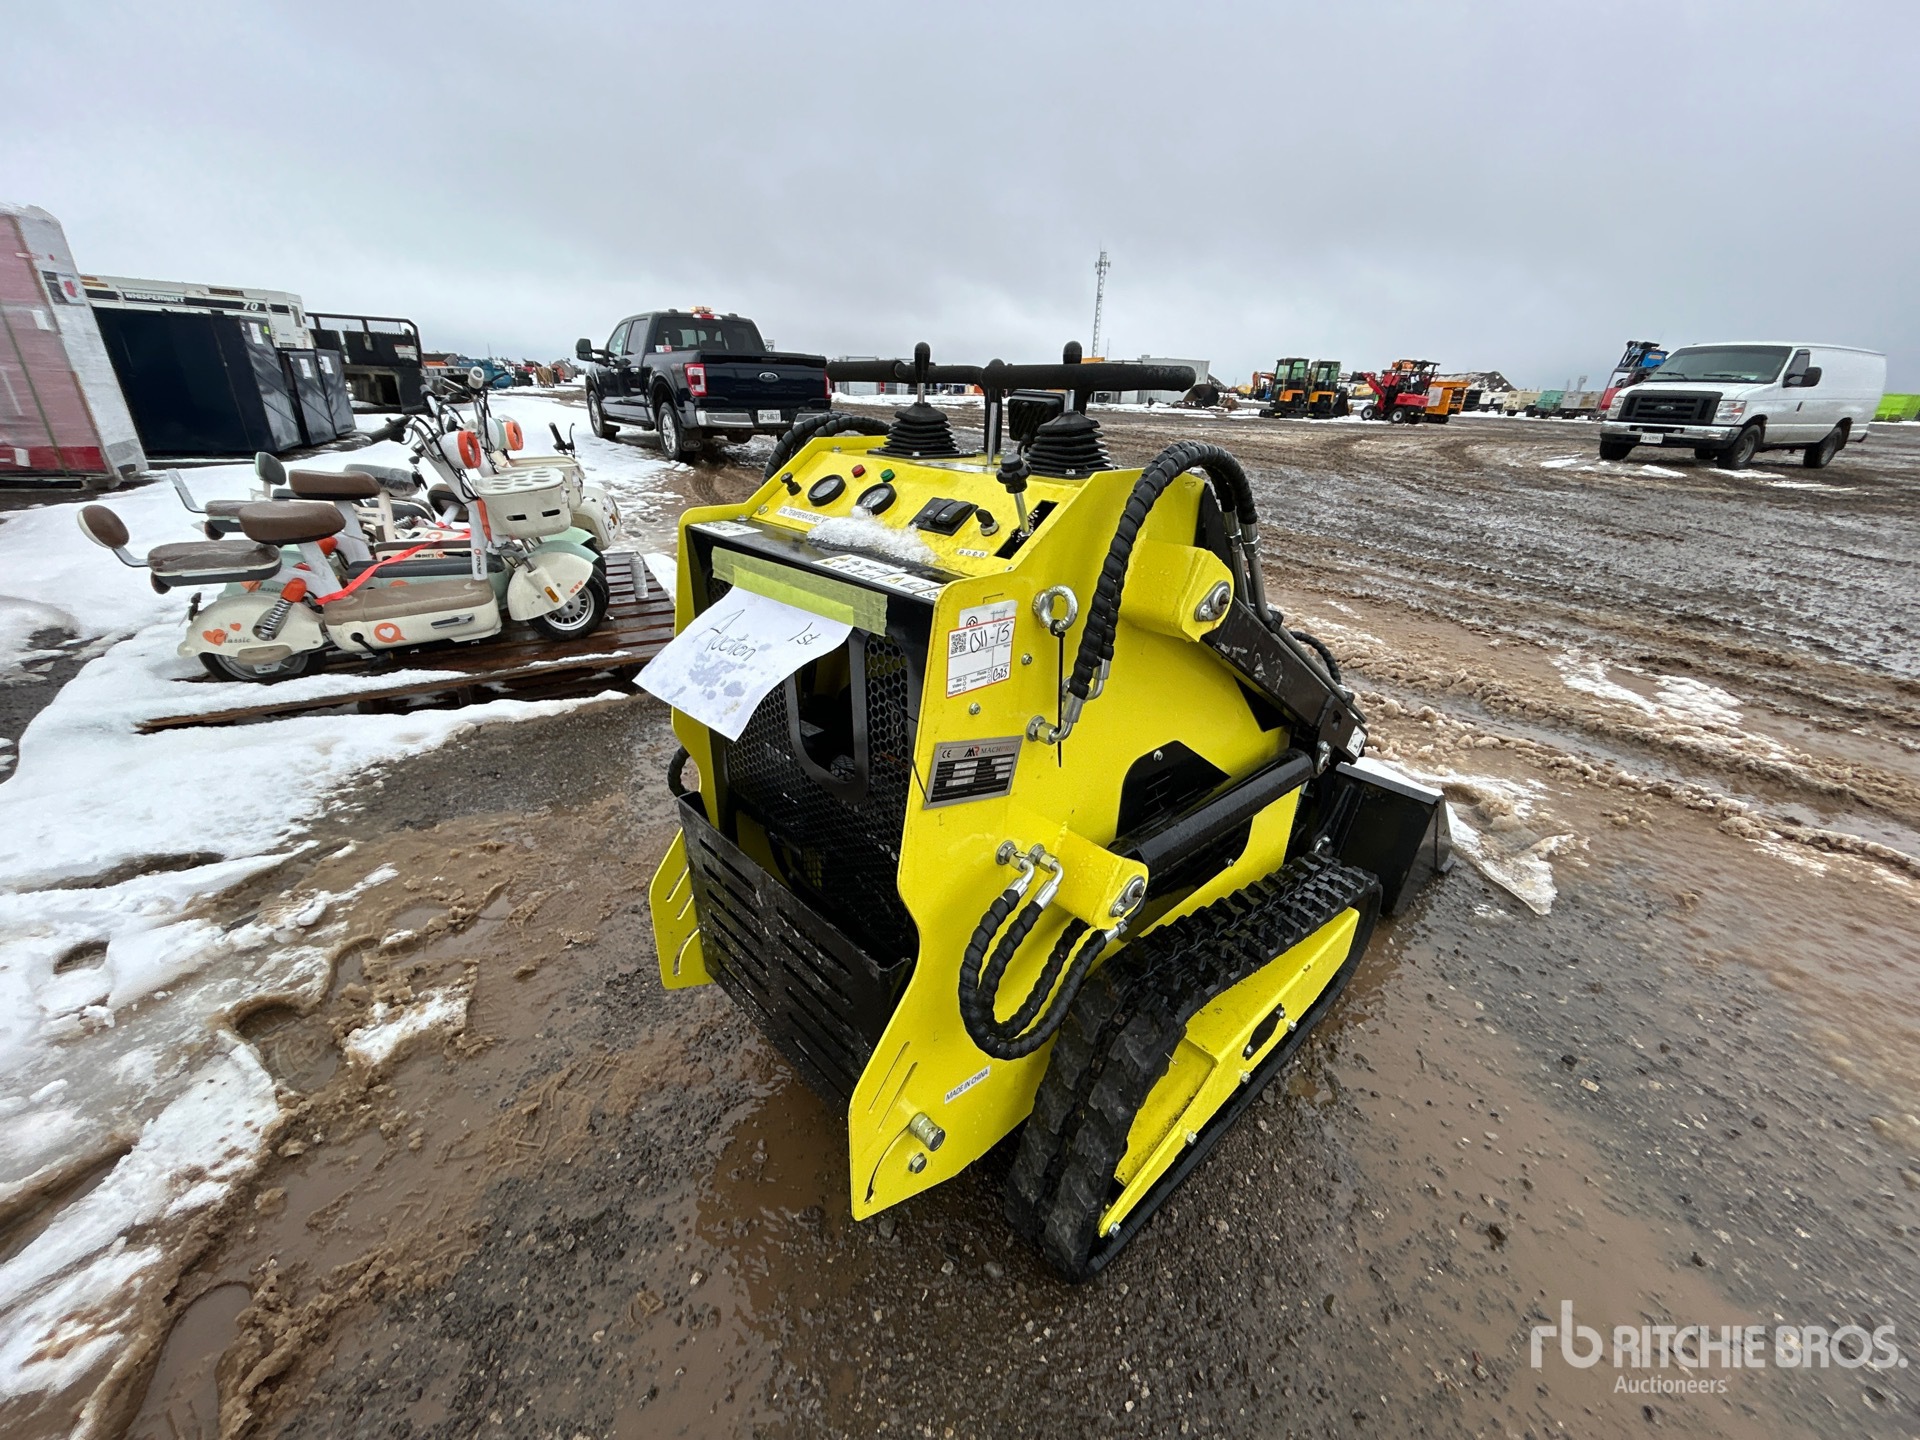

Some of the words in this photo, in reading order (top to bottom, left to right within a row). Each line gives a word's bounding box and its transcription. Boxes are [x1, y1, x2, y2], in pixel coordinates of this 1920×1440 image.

[243, 302, 259, 312] 70
[788, 509, 821, 523] TEMPERATURE
[981, 745, 1015, 754] MACHPRO
[946, 1084, 964, 1101] MADE
[964, 1080, 971, 1090] IN
[971, 1068, 988, 1085] CHINA
